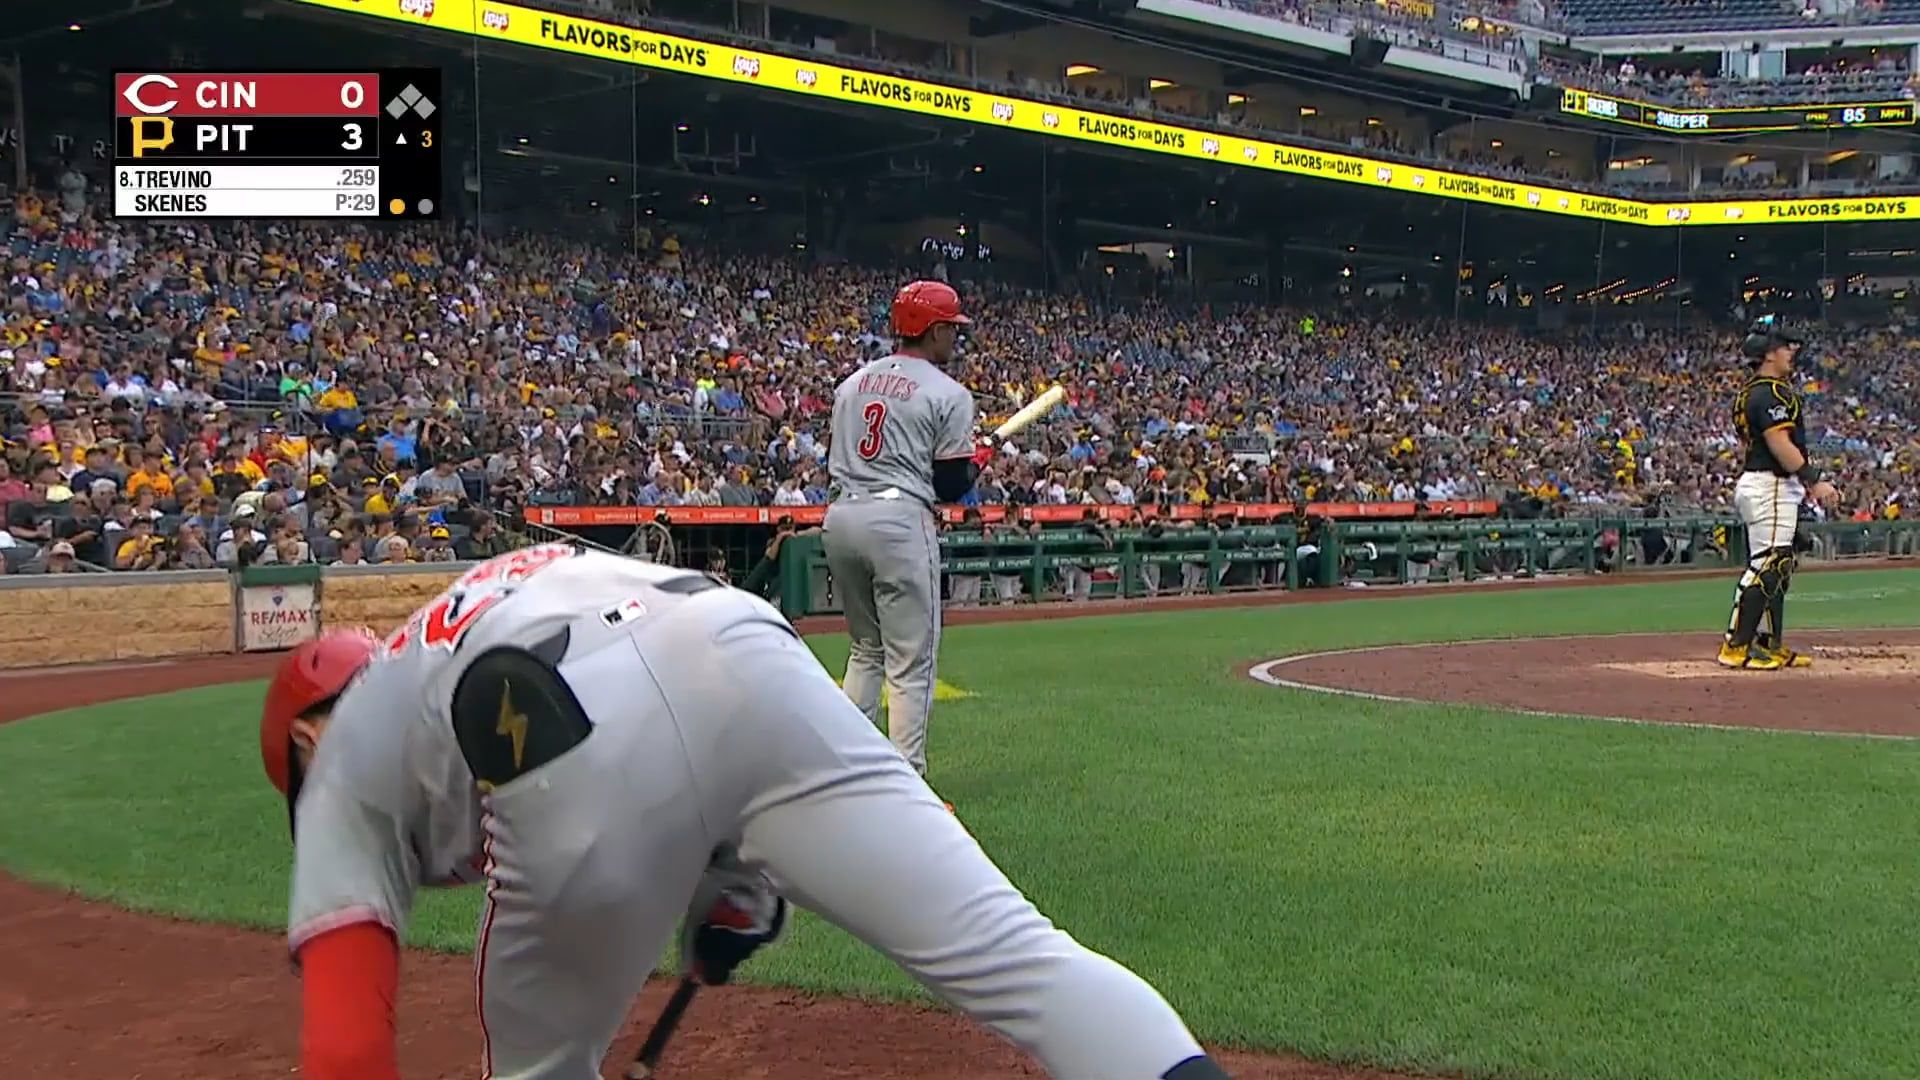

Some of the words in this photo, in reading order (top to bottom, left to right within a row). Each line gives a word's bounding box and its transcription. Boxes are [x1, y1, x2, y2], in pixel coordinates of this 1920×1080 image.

[541, 18, 631, 53] FLAVORS
[633, 40, 656, 54] FOR
[660, 41, 706, 67] DAYS
[841, 75, 911, 102] FLAVORS
[914, 91, 931, 103] FOR
[934, 92, 970, 112] DAYS
[1657, 111, 1709, 128] SWEEPER
[1843, 108, 1866, 123] 85
[1880, 109, 1905, 119] MPH
[1078, 117, 1136, 140] FLAVORS
[1138, 130, 1152, 140] FOR
[1154, 130, 1185, 148] DAYS
[1274, 150, 1322, 170] FLAVORS
[1337, 160, 1363, 176] DAYS
[1438, 176, 1479, 195] FLAVORS
[1492, 185, 1515, 200] DAYS
[1581, 198, 1616, 215] FLAVORS
[1629, 206, 1648, 219] DAYS
[1769, 203, 1841, 217] FLAVORS
[1865, 201, 1906, 214] DAYS
[858, 373, 920, 400] HAYES
[857, 400, 886, 462] 3
[251, 610, 307, 625] RE/MAX
